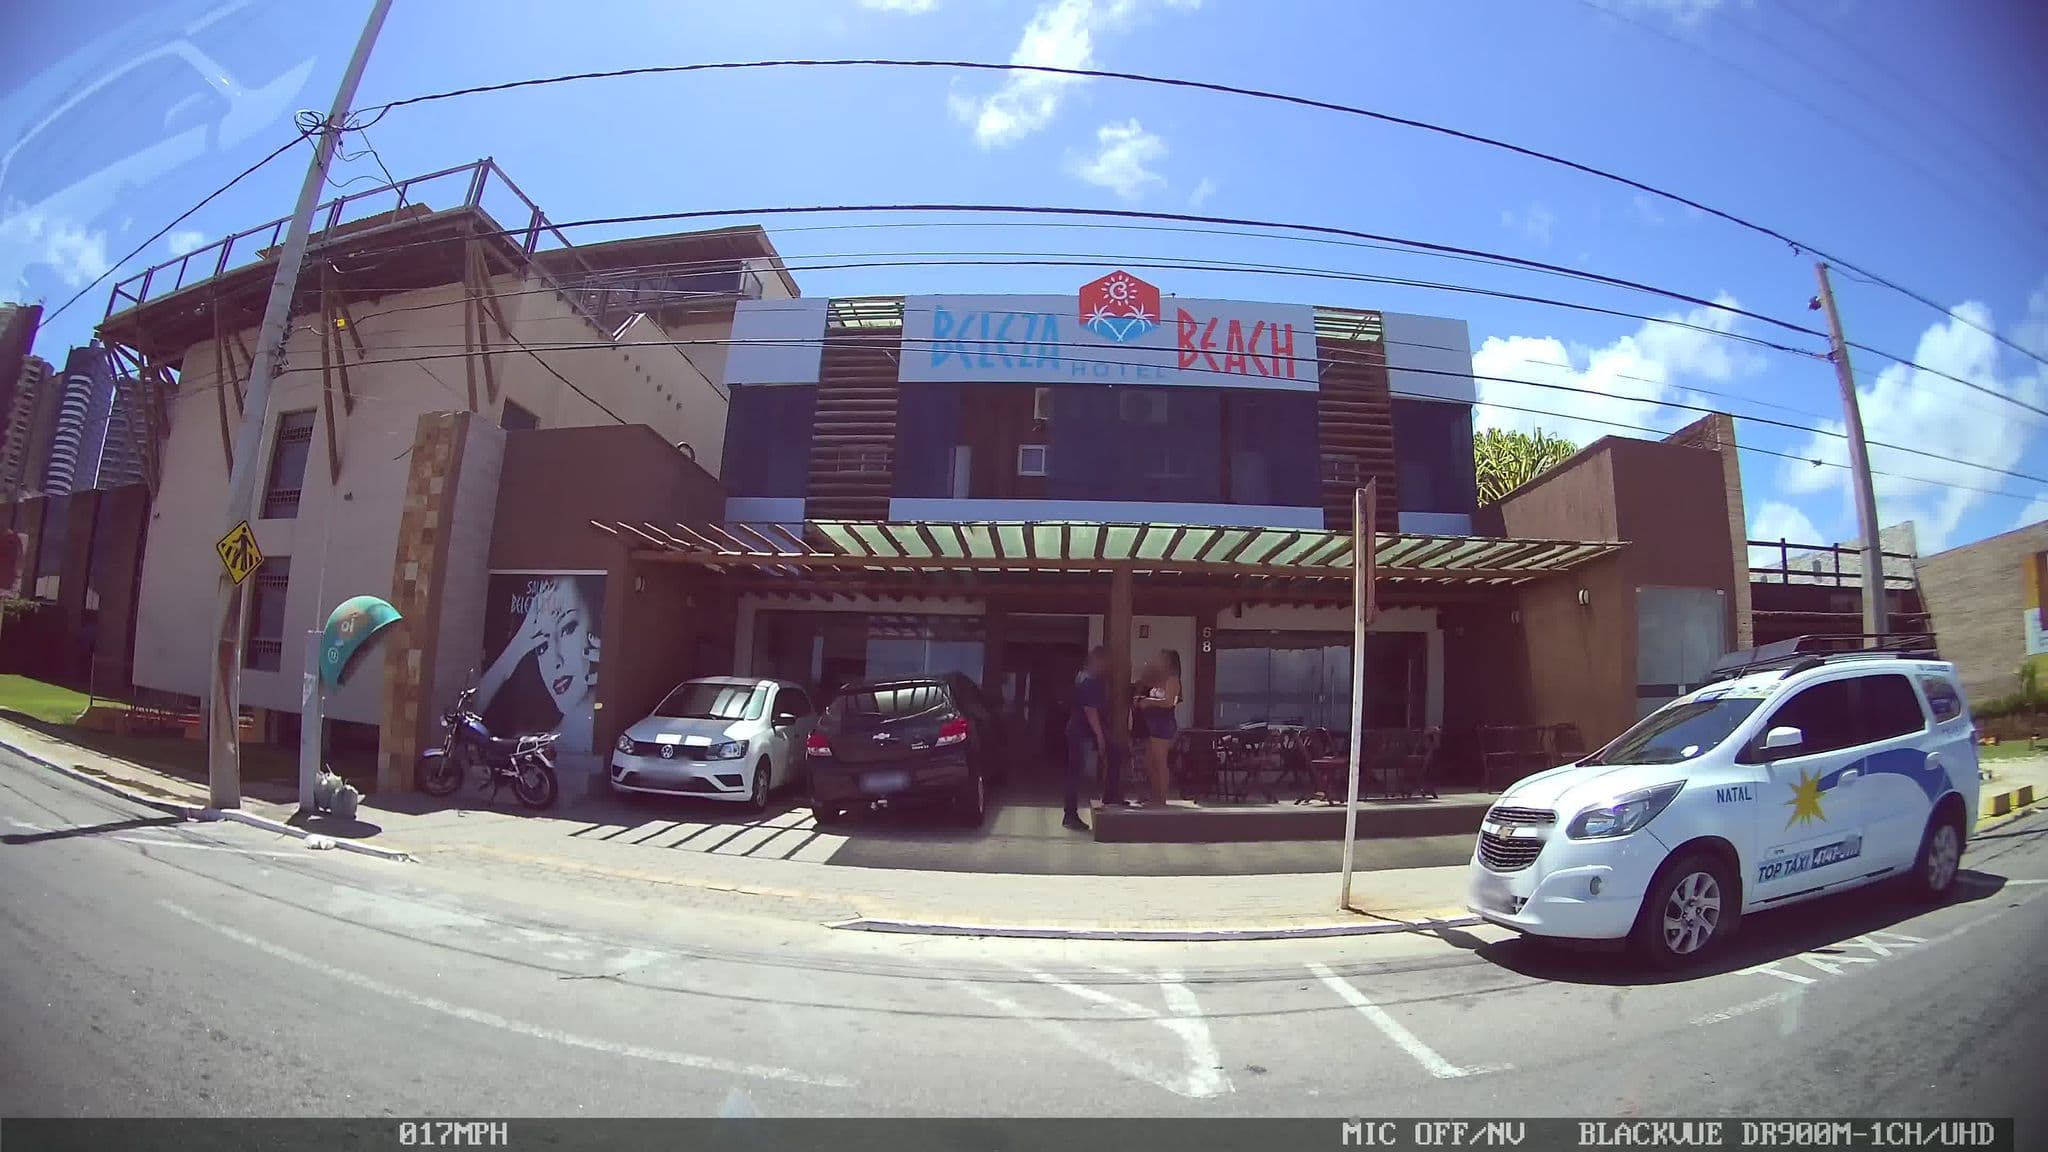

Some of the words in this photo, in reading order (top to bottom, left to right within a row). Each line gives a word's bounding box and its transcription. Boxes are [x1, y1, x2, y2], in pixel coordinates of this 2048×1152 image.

[931, 305, 1060, 369] BELEZA
[1177, 308, 1295, 379] BEACH
[1071, 361, 1167, 379] HOTEL
[1716, 786, 1752, 803] NATAL
[1758, 862, 1783, 883] TOP
